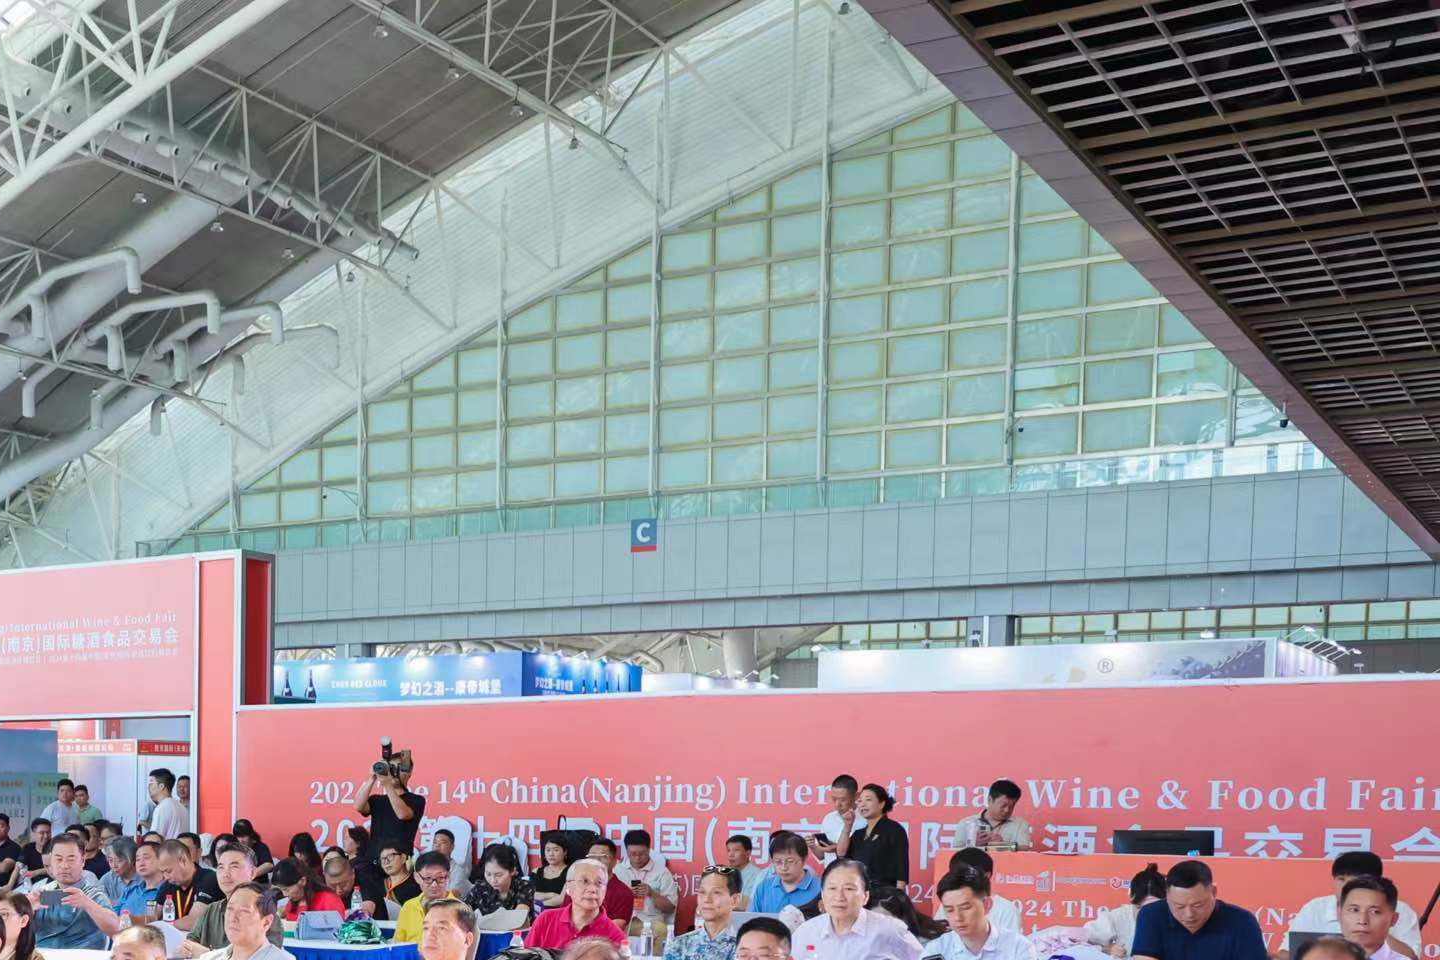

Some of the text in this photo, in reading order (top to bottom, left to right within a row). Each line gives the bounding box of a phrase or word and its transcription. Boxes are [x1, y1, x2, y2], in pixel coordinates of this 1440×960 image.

[637, 522, 650, 542] C
[310, 781, 366, 804] 202
[437, 777, 486, 804] 14th
[491, 775, 727, 811] China(Nanjing)
[1025, 777, 1141, 810] Wine
[1156, 779, 1190, 810] &
[1207, 776, 1327, 811] Food
